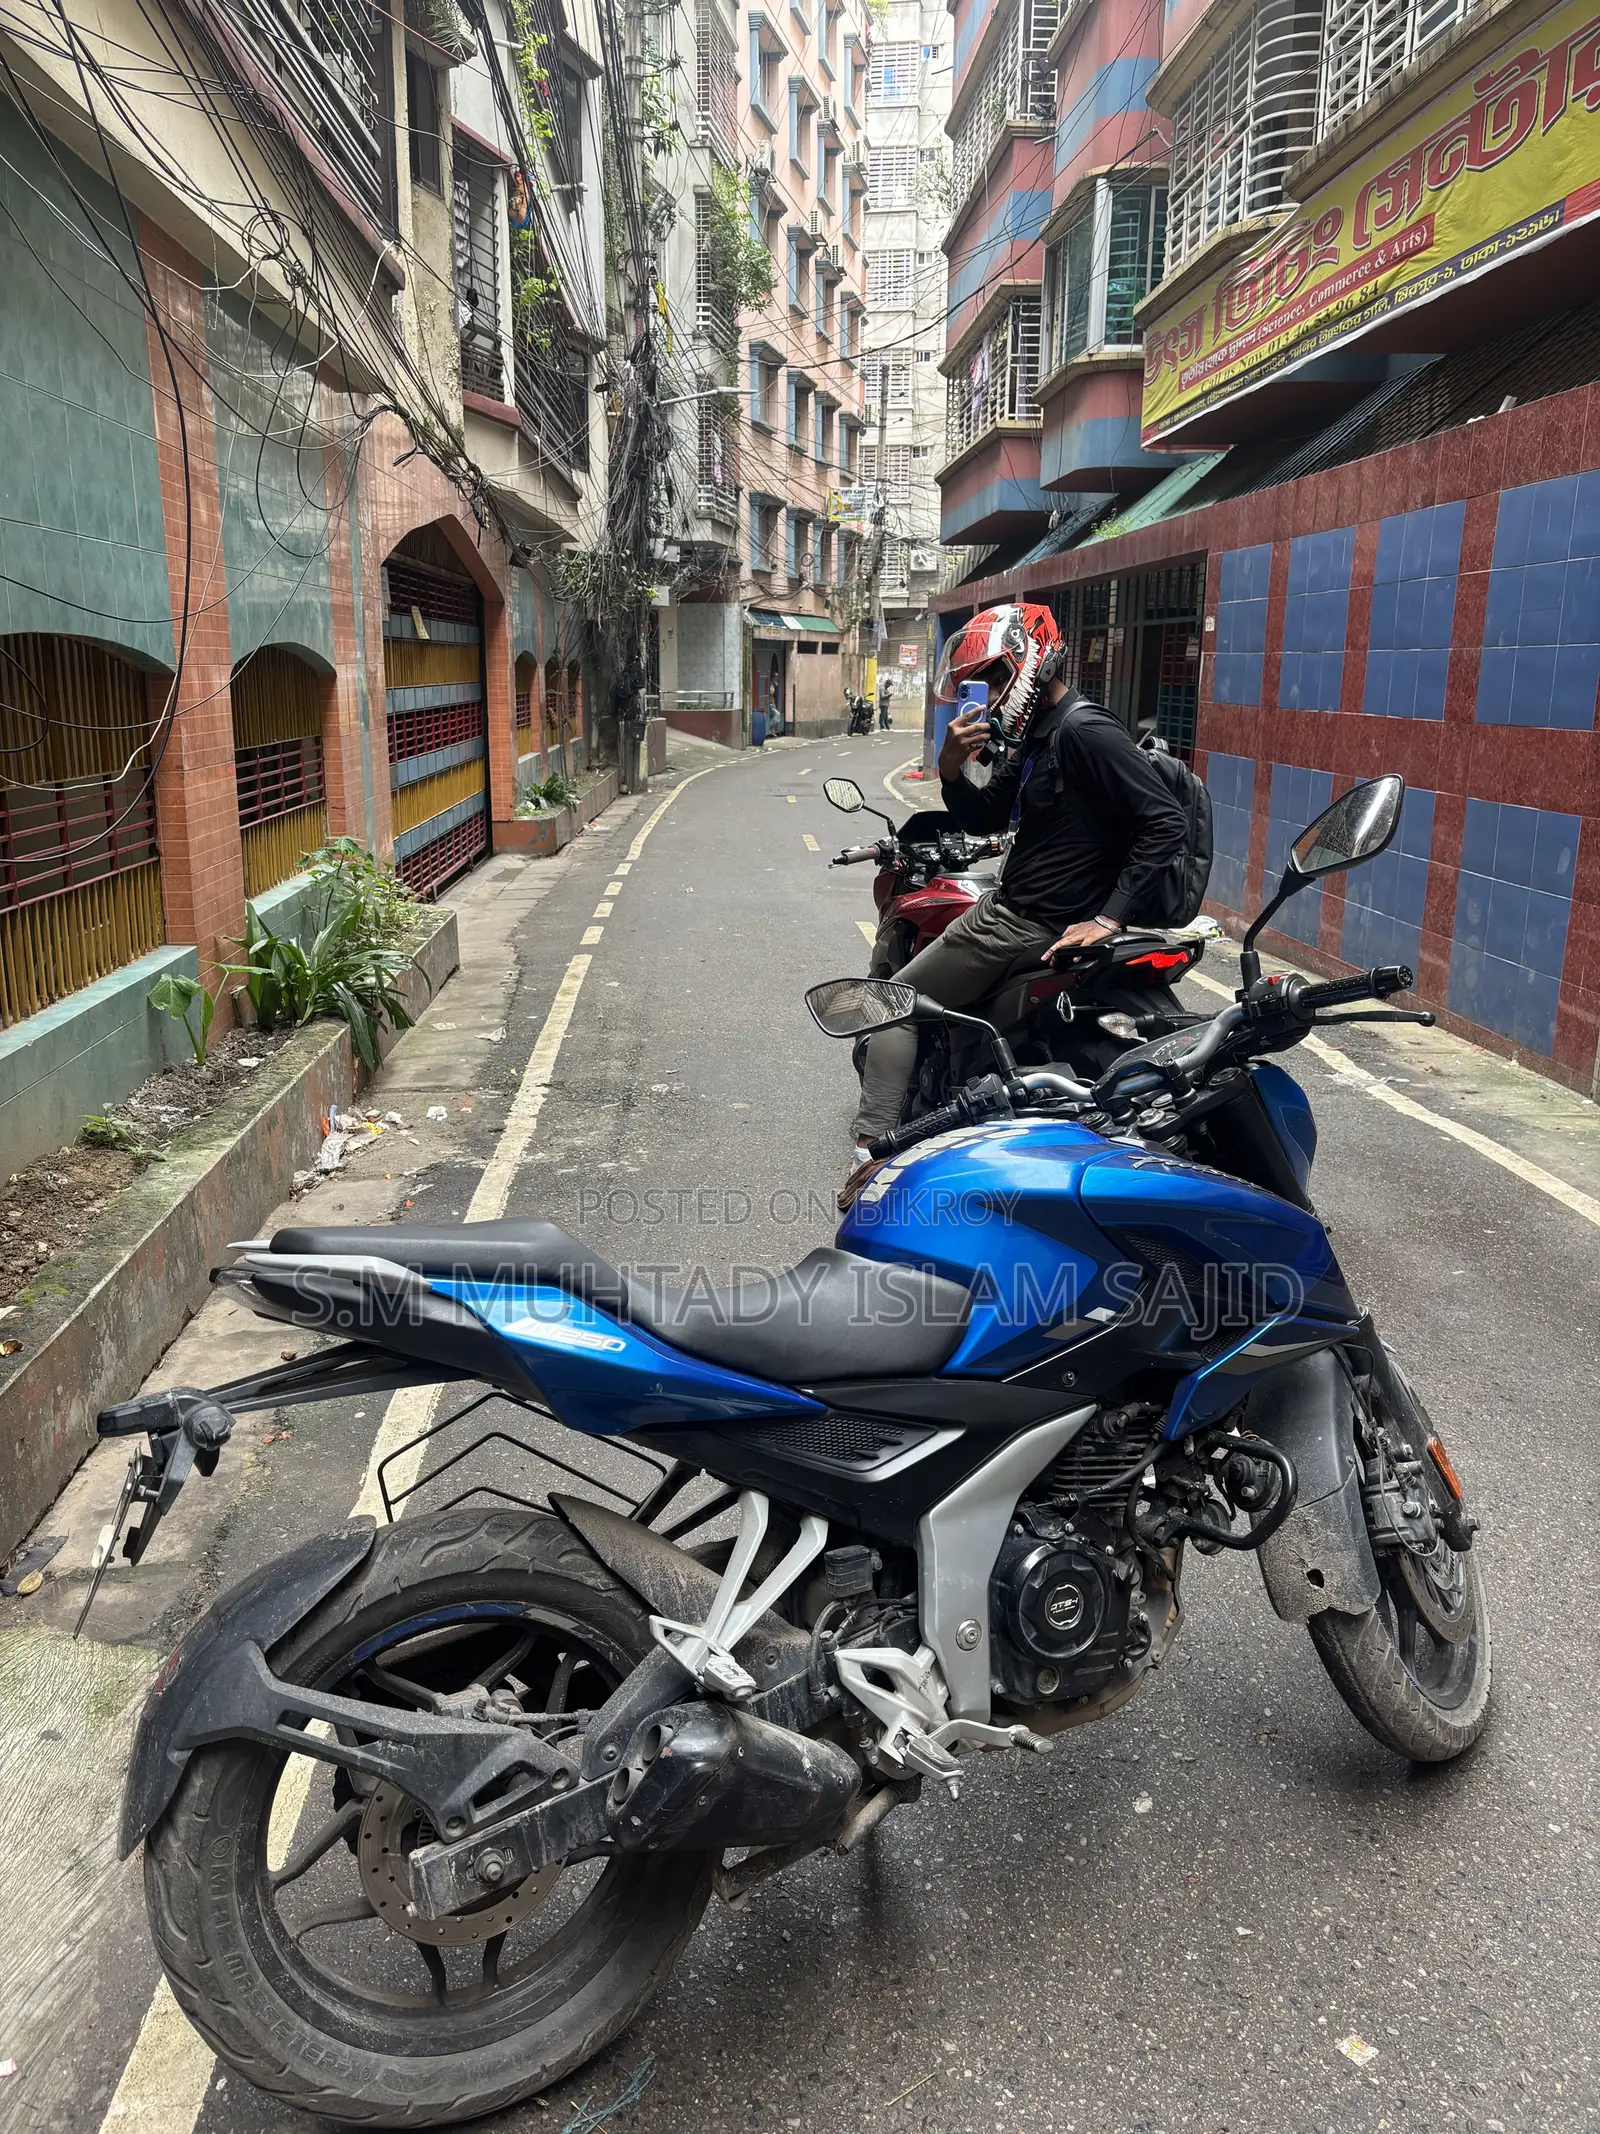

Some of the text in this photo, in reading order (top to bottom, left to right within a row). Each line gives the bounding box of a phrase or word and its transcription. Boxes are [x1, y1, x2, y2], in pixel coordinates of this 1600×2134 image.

[1257, 304, 1305, 343] (Science,
[1309, 262, 1371, 308] Commerce
[1374, 249, 1387, 269] &
[1390, 224, 1428, 261] Arts)
[1394, 265, 1456, 305] মিরপুর-১,
[1142, 303, 1208, 388] উৎস
[1201, 371, 1220, 393] Call
[1224, 366, 1236, 380] us
[1239, 350, 1263, 368] Now
[1335, 293, 1354, 314] 96
[1359, 279, 1380, 302] 84
